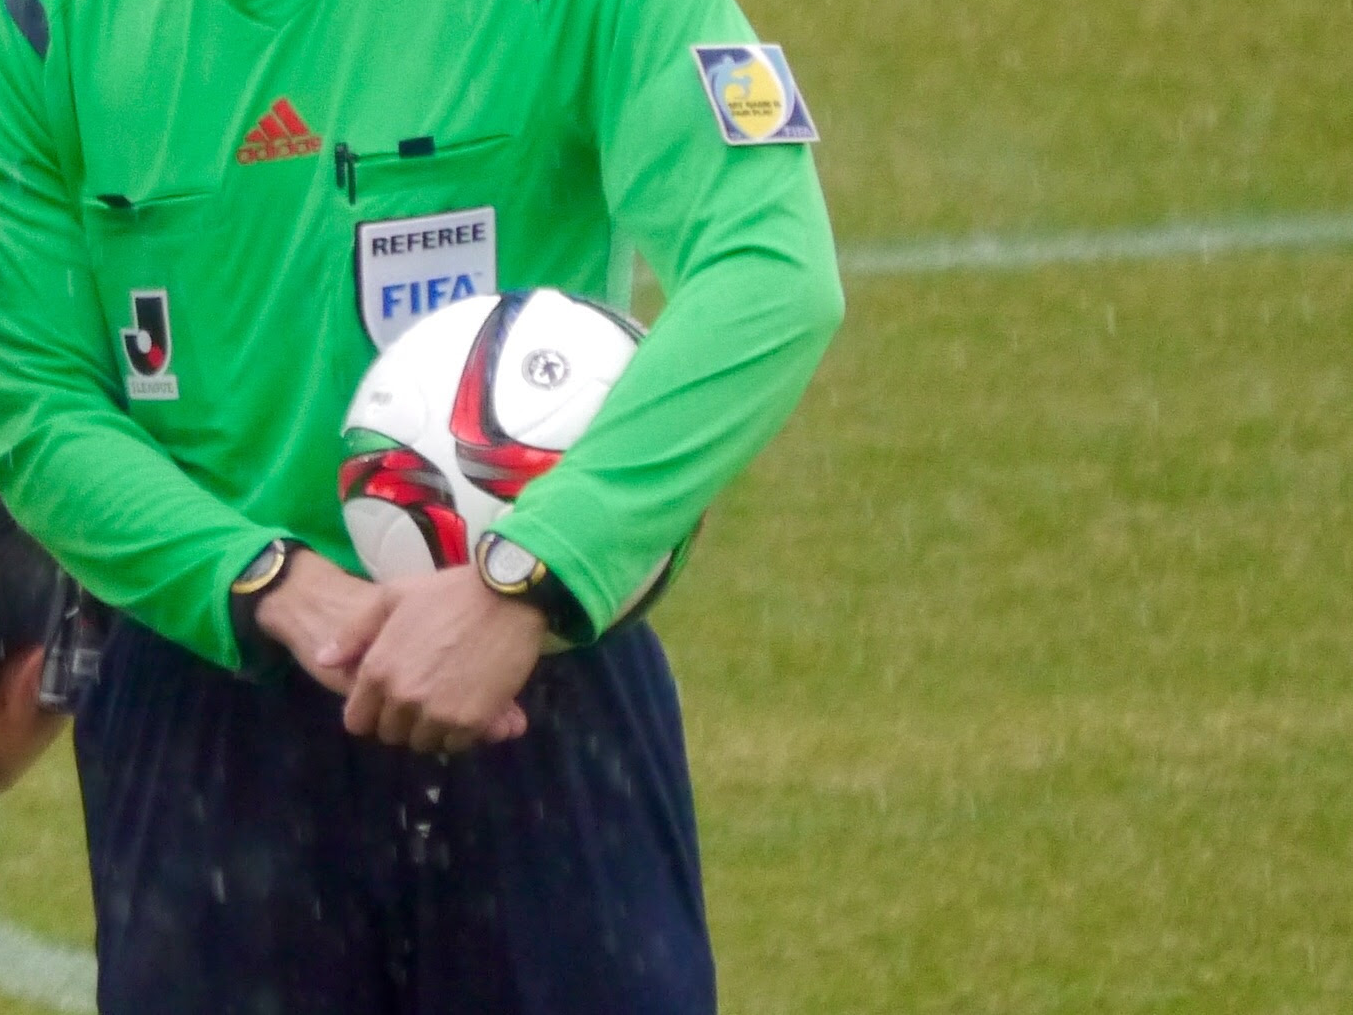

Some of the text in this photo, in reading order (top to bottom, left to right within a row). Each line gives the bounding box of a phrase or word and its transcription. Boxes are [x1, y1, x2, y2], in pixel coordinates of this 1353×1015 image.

[236, 135, 322, 164] adidas
[371, 221, 487, 257] REFEREE
[381, 273, 476, 320] FIFA
